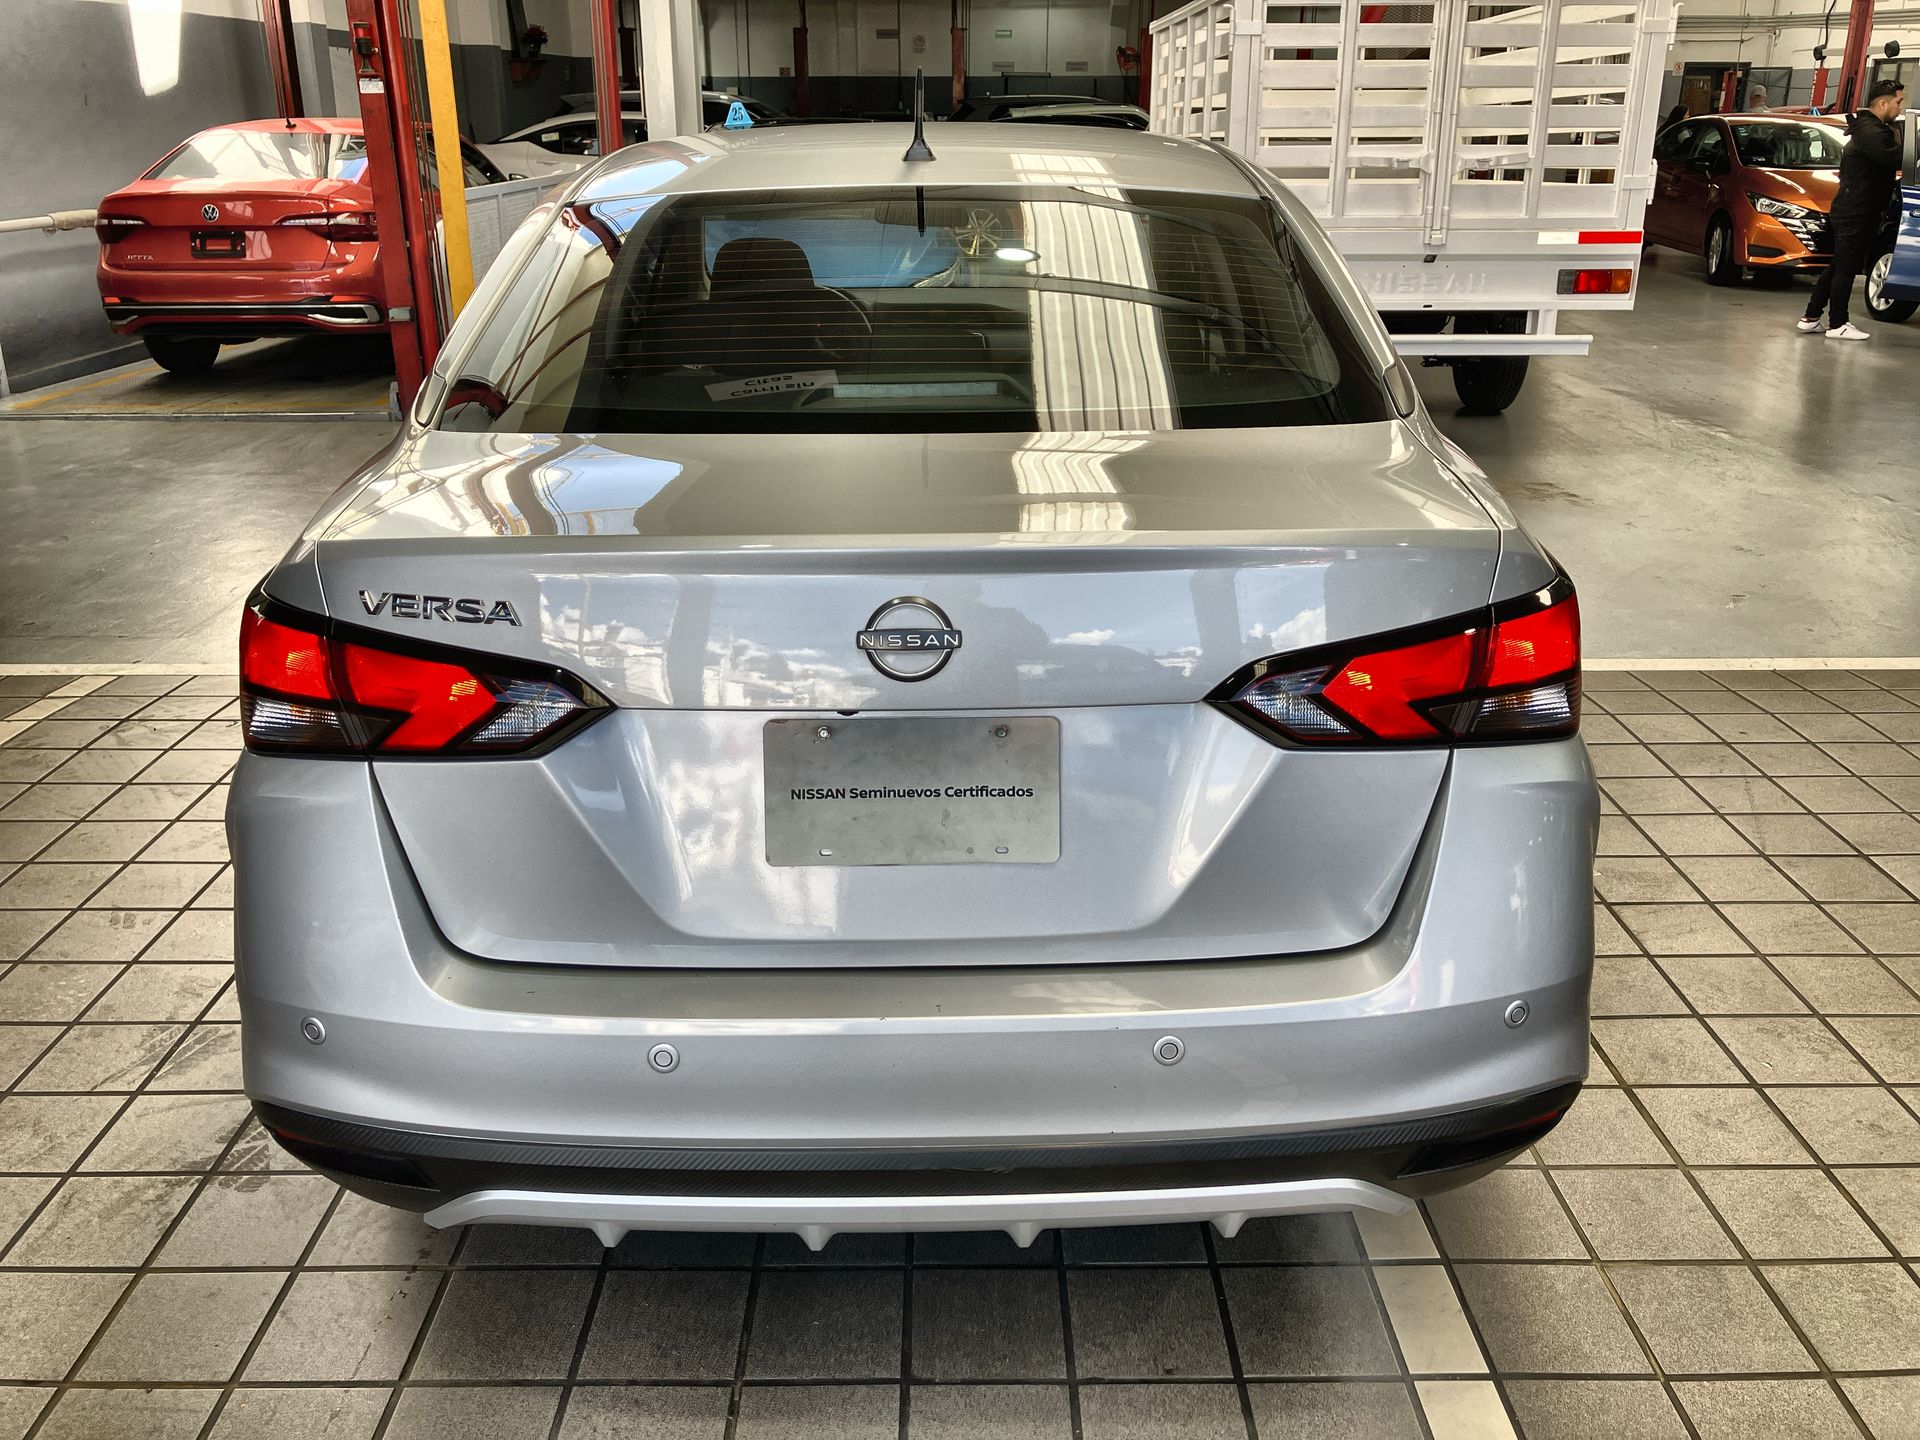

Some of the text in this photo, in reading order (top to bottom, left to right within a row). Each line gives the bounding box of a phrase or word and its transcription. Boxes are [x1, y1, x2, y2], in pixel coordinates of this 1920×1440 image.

[731, 107, 744, 121] 25
[1363, 271, 1487, 294] NISSAN
[358, 590, 523, 627] VERSA
[859, 633, 959, 647] NISSAN
[790, 785, 1034, 800] NISSAN Seminuevos Certificados
